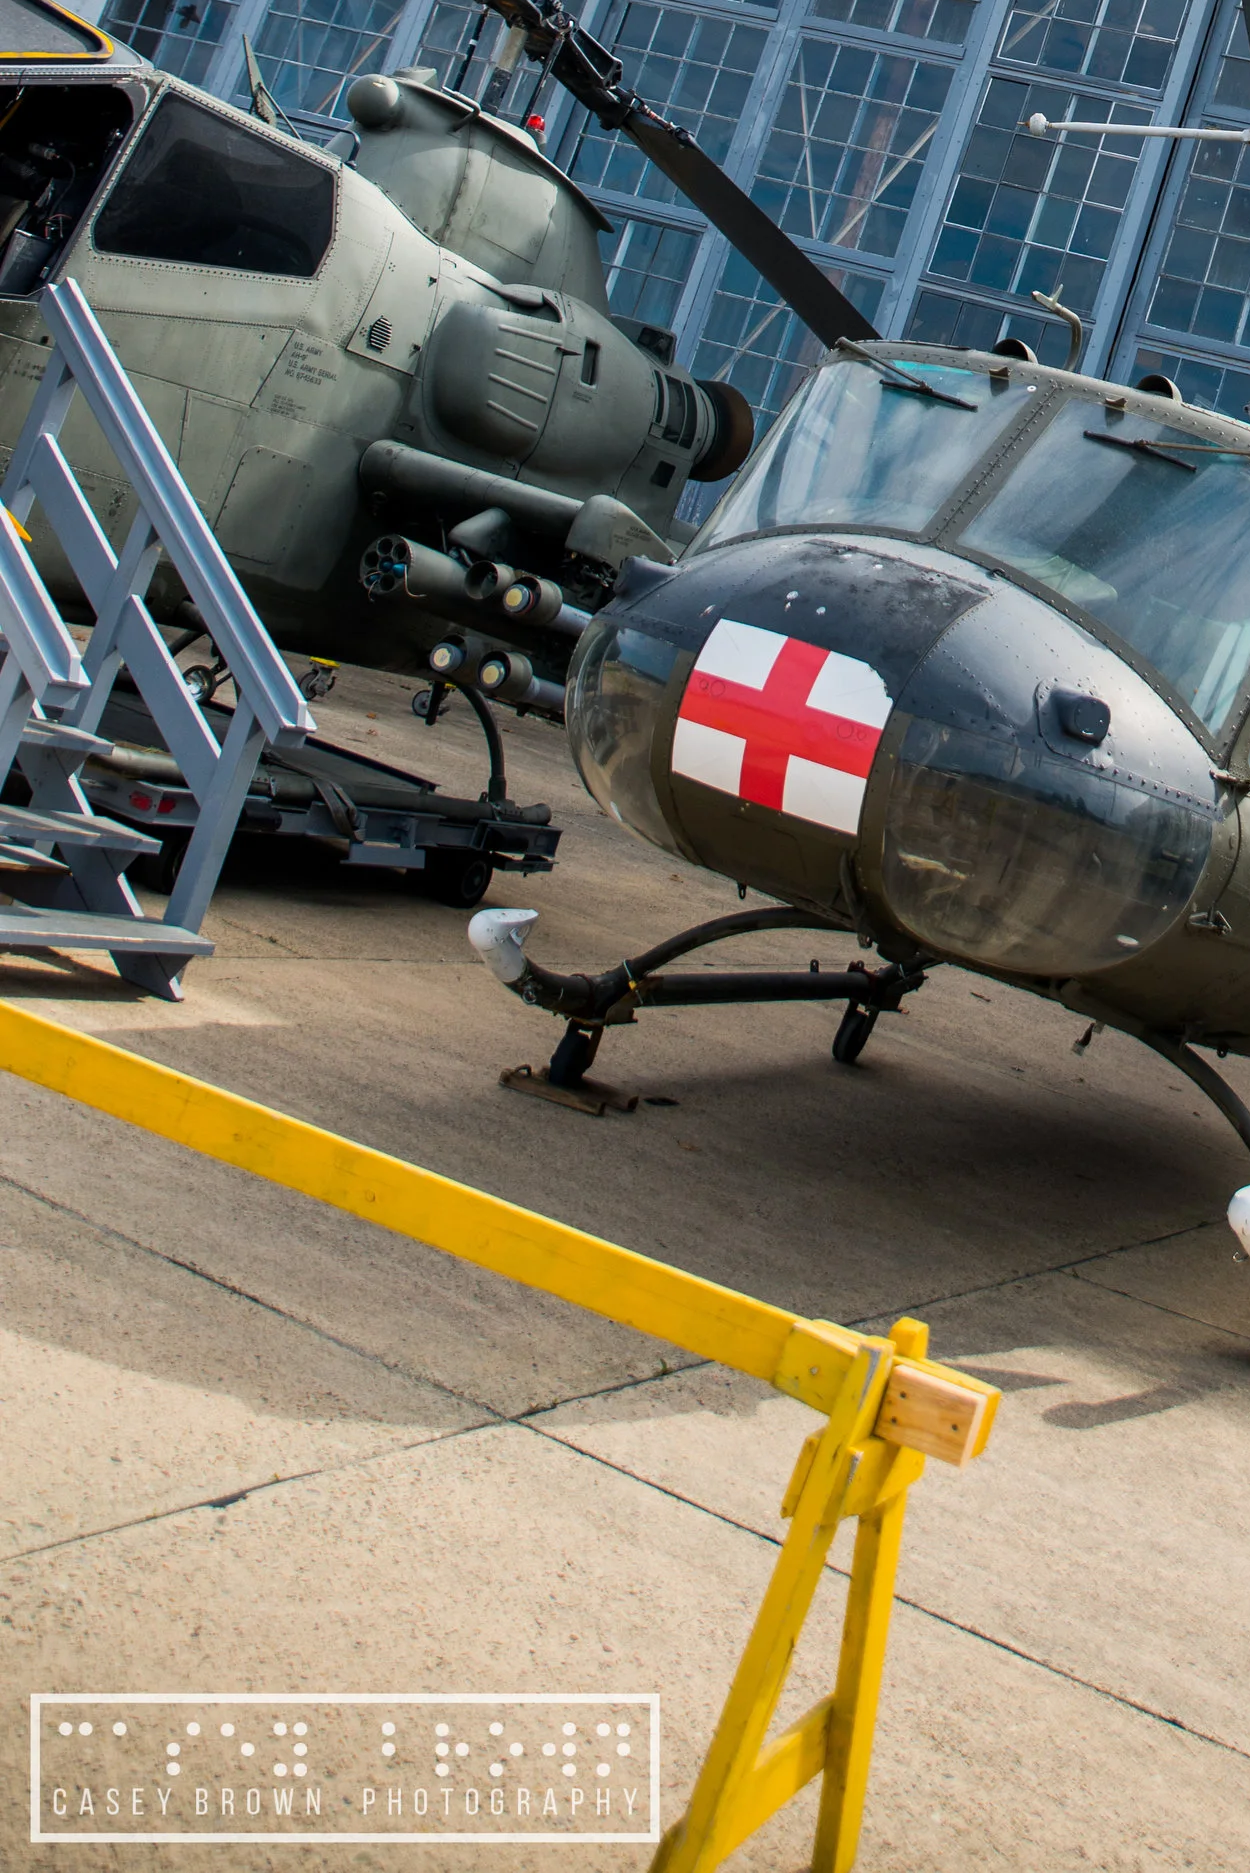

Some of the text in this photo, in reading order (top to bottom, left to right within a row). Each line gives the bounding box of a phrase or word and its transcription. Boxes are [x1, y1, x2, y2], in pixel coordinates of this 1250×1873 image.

[306, 346, 323, 356] ARMY
[300, 364, 318, 375] ARMY
[317, 368, 337, 381] SERIAL
